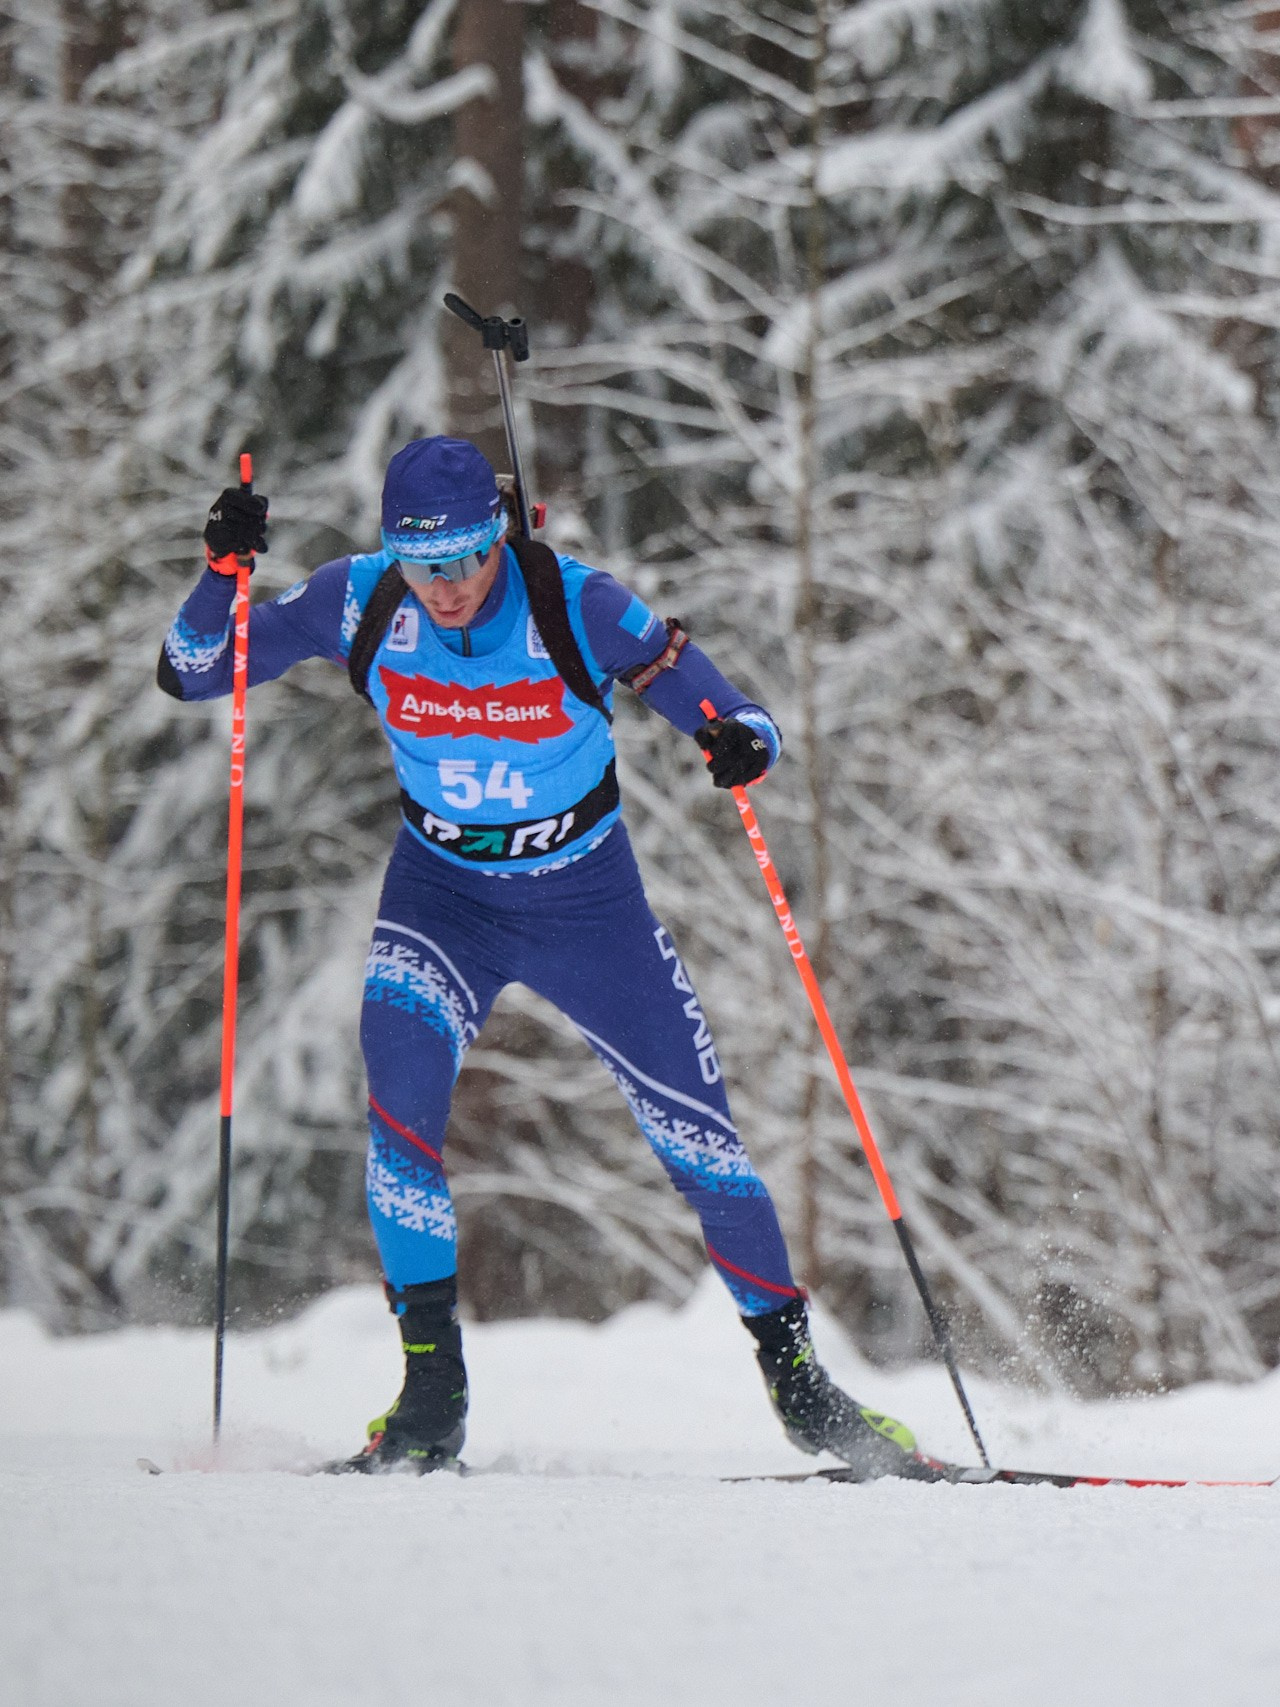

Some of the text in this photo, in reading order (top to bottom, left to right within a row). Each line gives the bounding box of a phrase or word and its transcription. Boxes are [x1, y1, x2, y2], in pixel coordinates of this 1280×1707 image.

[400, 693, 552, 723] Альфа Банк
[438, 759, 534, 810] 54
[423, 811, 575, 857] PARI
